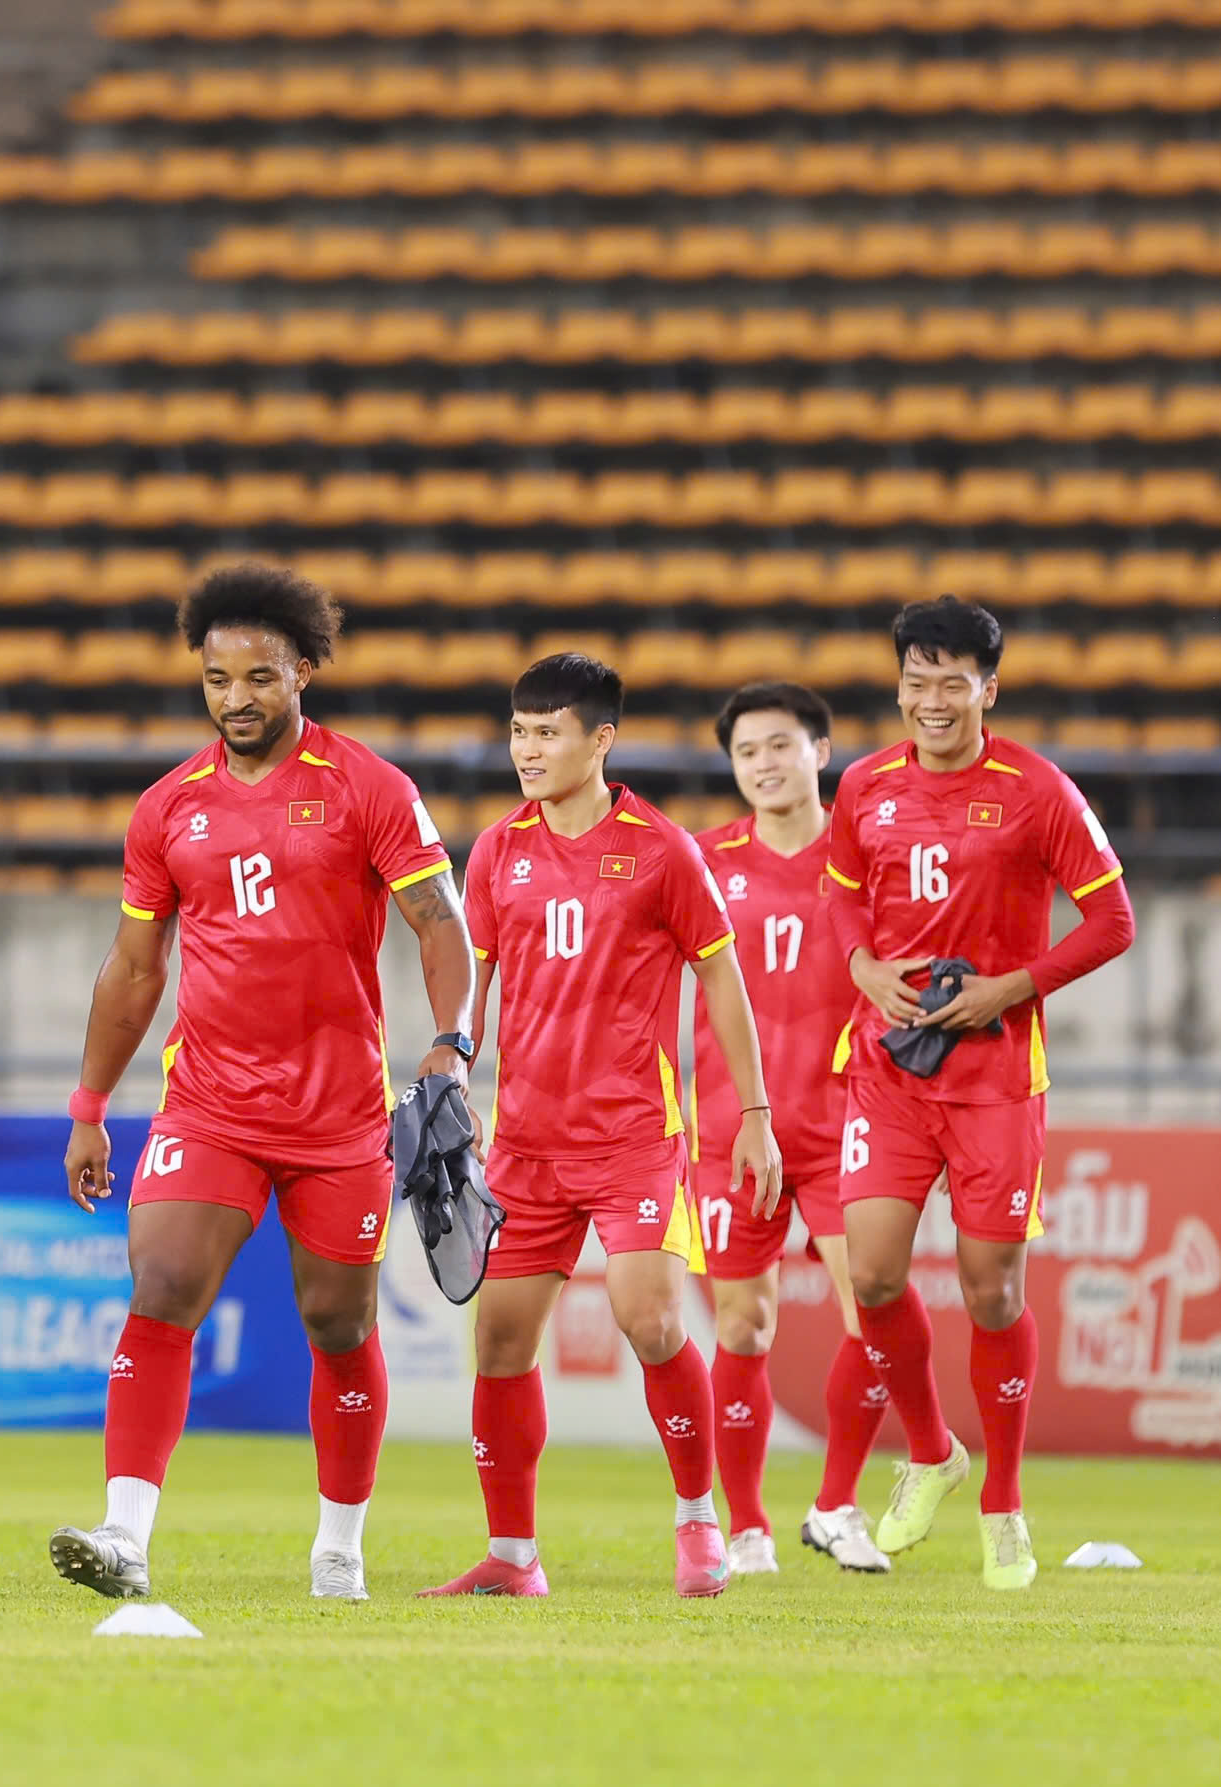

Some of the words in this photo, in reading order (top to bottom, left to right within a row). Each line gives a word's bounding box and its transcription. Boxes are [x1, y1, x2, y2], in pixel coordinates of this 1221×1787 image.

[229, 852, 276, 919] 12
[910, 843, 949, 903] 16
[545, 897, 584, 960] 10
[764, 914, 804, 973] 17
[701, 1195, 733, 1253] 17
